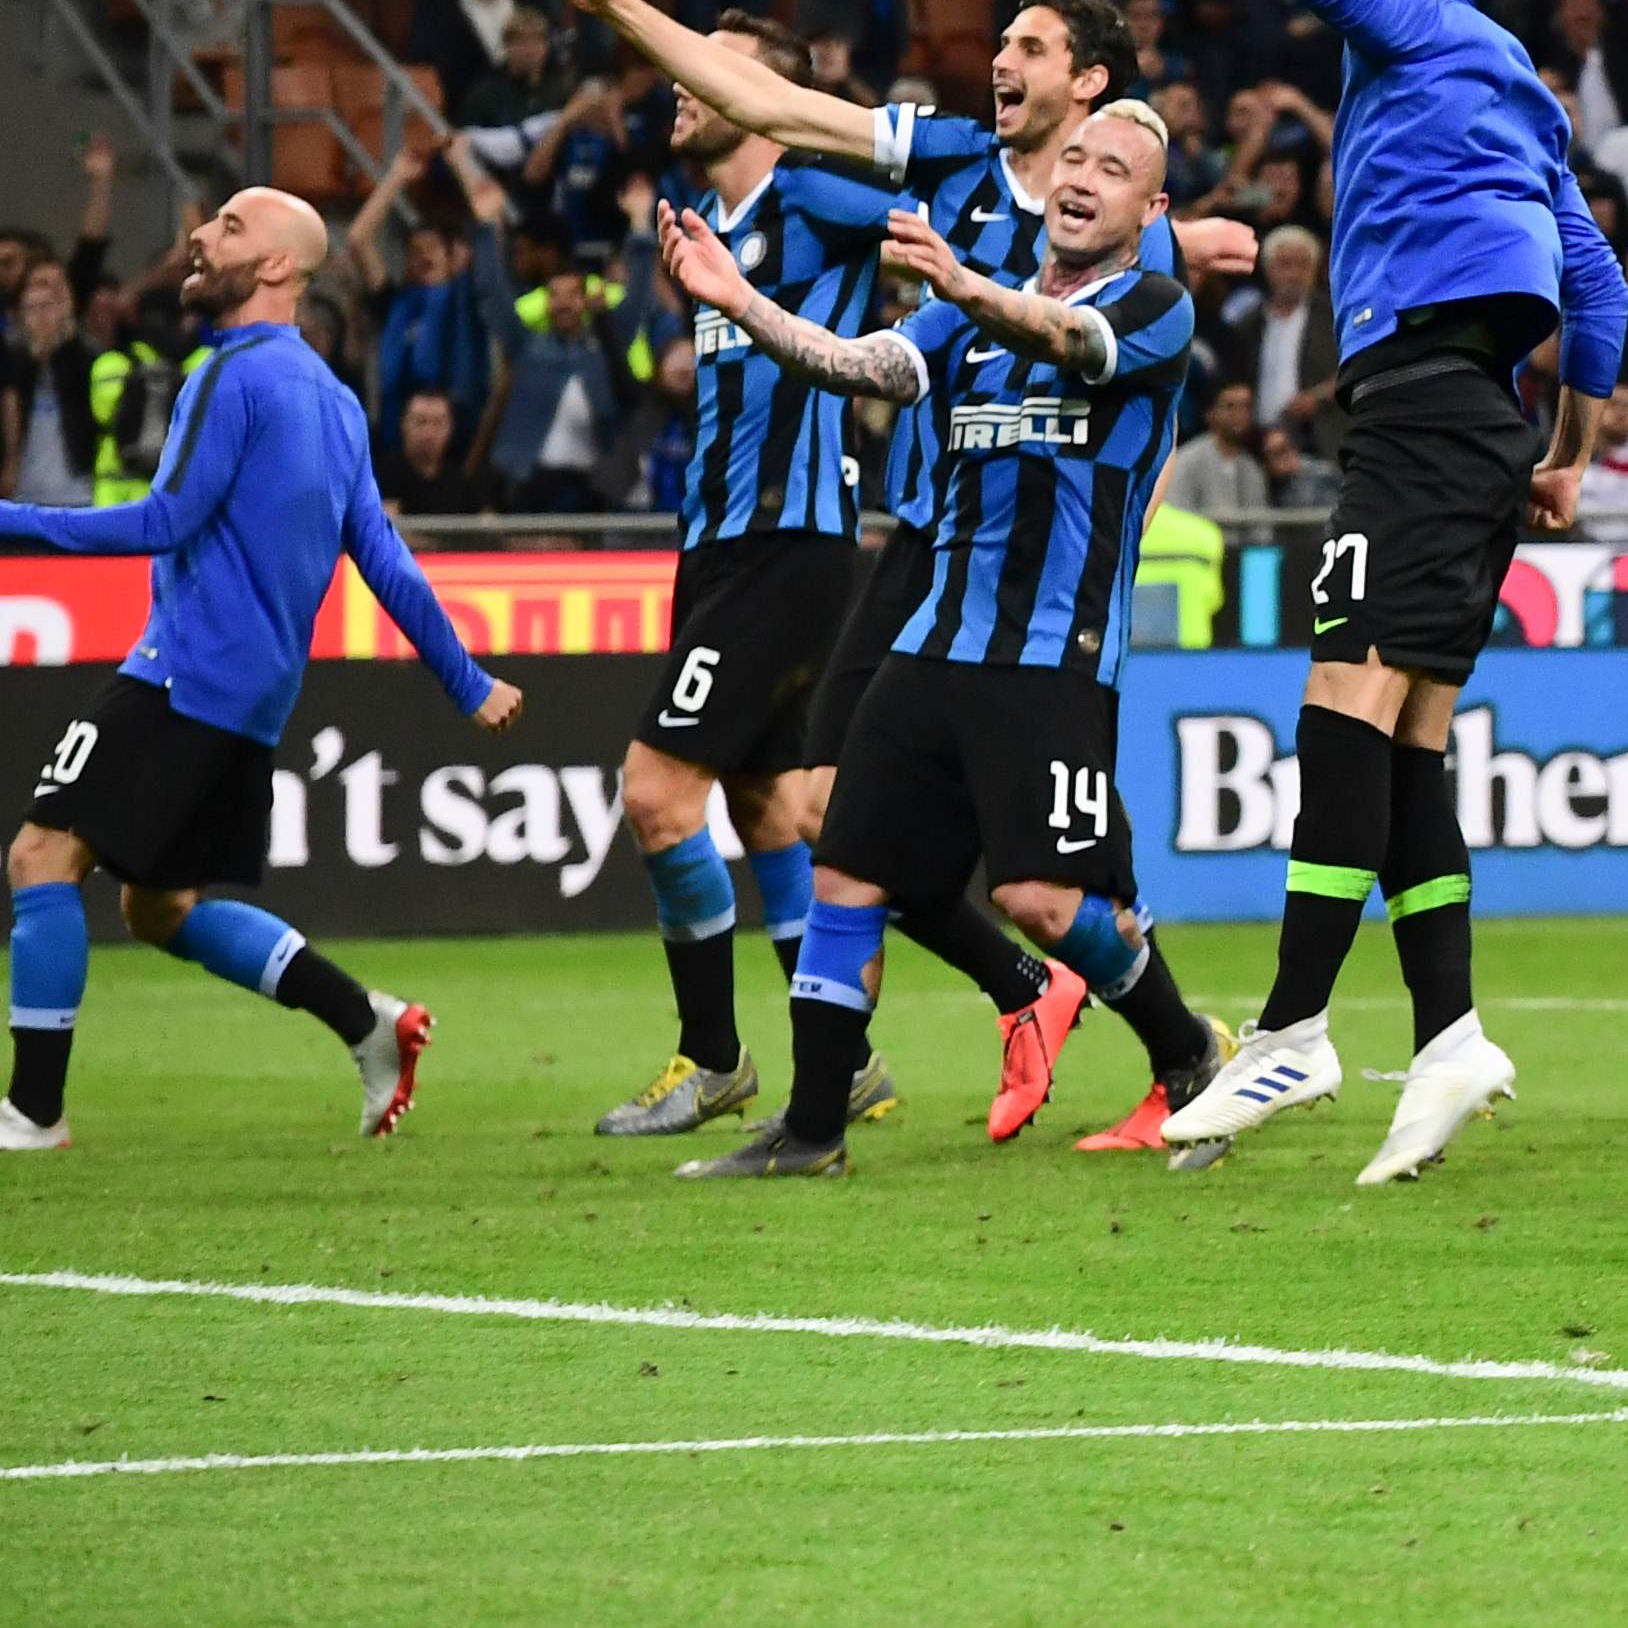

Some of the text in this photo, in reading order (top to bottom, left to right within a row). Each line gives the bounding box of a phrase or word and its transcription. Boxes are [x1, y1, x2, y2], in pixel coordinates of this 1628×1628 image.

[1311, 533, 1368, 605] 27
[672, 647, 721, 713] 6
[420, 765, 624, 898] say
[1049, 761, 1108, 838] 14
